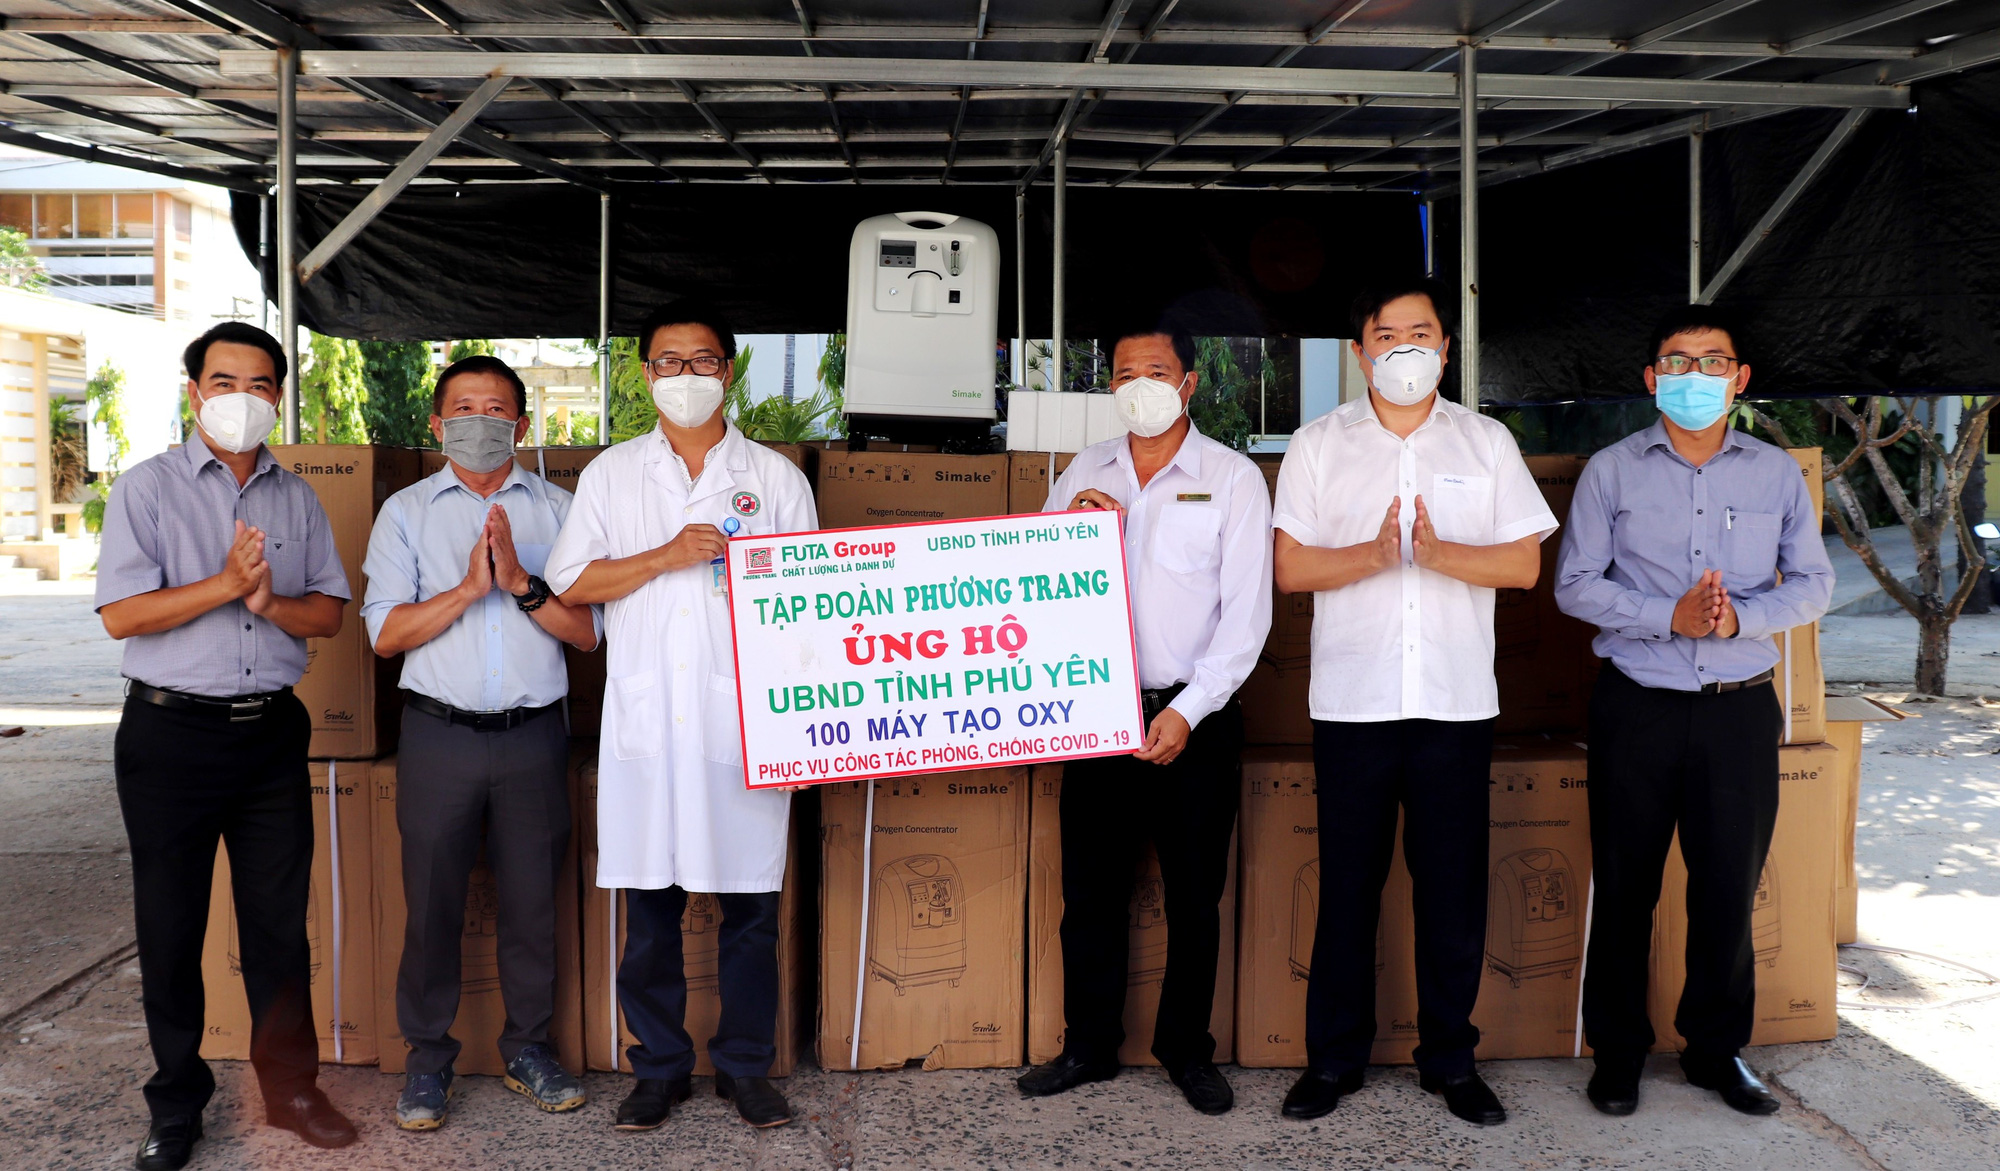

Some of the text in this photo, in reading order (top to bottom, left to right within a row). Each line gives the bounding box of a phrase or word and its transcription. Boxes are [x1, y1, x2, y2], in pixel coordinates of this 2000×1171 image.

[952, 390, 982, 398] Simake
[293, 462, 354, 474] Simake
[934, 470, 992, 482] Simake
[866, 507, 944, 518] Oxygen Concentrator
[927, 522, 1099, 552] UBND TỈNH PHÚ YÊN
[781, 541, 896, 562] FUTA Group
[782, 558, 895, 578] CHẤT LƯỢNG LÀ DANH DỰ
[753, 569, 1109, 630] TẬP ĐOÀN PHƯƠNG TRANG
[842, 613, 1028, 666] ỦNG HỘ
[768, 653, 1110, 714] UBND TỈNH PHÚ YÊN
[805, 699, 1074, 747] 100 MÁY TẠO OXY
[758, 760, 803, 781] PHỤC
[807, 758, 829, 778] VỤ
[834, 751, 881, 773] CÔNG
[885, 747, 917, 768] TÁC
[922, 742, 983, 765] PHÒNG,
[988, 737, 1045, 759] CHỐNG
[1050, 732, 1099, 752] COVID
[1113, 729, 1130, 746] 19
[1779, 769, 1818, 780] make
[947, 782, 1009, 795] Simake
[1560, 777, 1588, 789] Sim
[873, 824, 958, 834] Oxygen Concentrator
[1293, 825, 1320, 835] Oxyge
[1489, 819, 1570, 829] Oxygen Concentrator
